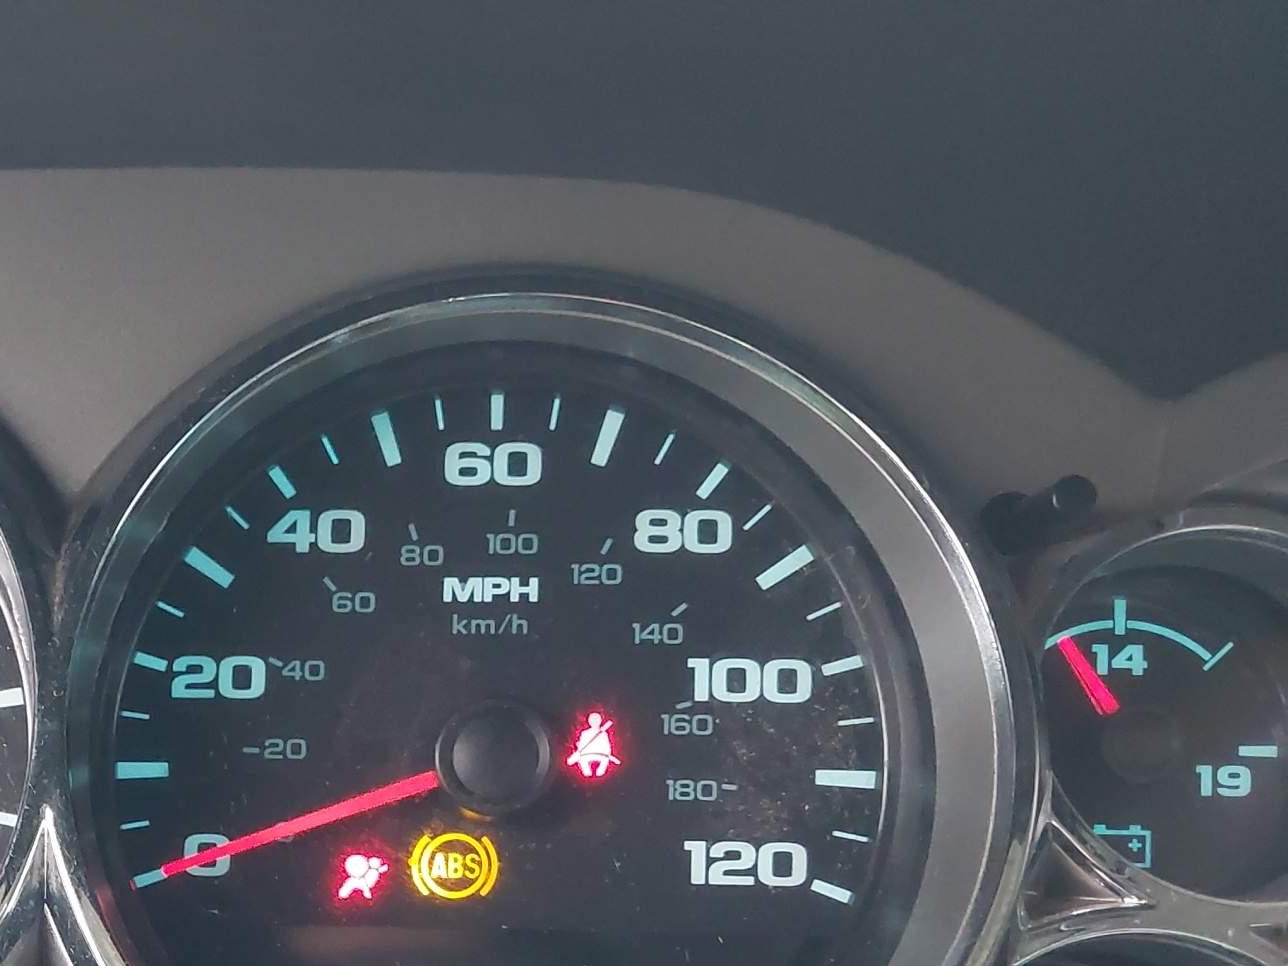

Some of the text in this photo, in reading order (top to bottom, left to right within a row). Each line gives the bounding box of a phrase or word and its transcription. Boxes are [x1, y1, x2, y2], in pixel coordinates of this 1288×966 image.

[444, 442, 542, 486] 60
[266, 510, 366, 554] 40
[486, 532, 538, 555] 100
[634, 510, 733, 554] 80
[400, 543, 444, 567] 80
[571, 562, 623, 586] 120
[332, 591, 376, 614] 60
[443, 576, 539, 603] MPH
[451, 613, 528, 636] km/h
[633, 623, 683, 646] 140
[281, 660, 325, 682] 40
[1091, 644, 1148, 675] 14
[171, 656, 266, 699] 20
[687, 658, 812, 702] 100
[661, 714, 712, 736] 160
[263, 738, 307, 760] 20
[666, 779, 717, 802] 180
[1196, 765, 1252, 797] 19
[183, 834, 230, 877] 0
[430, 852, 481, 879] ABS
[684, 841, 808, 886] 120
